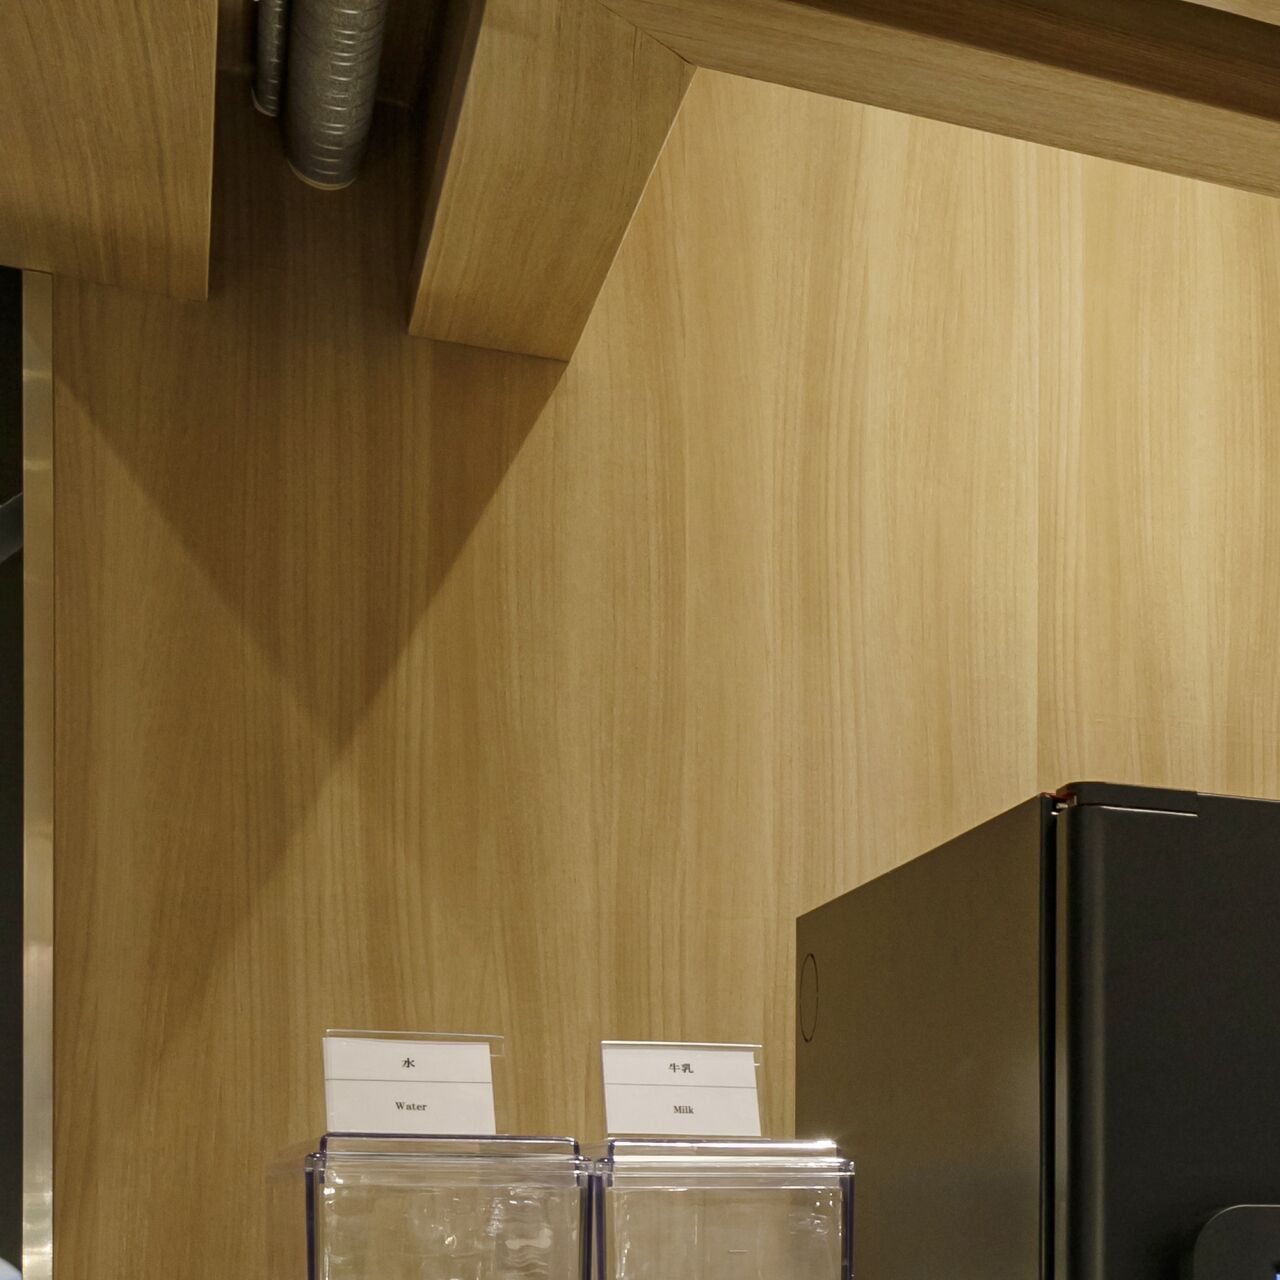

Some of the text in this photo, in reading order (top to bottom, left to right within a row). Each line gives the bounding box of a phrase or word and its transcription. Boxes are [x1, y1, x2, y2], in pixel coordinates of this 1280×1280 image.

[401, 1057, 415, 1069] 水
[669, 1062, 694, 1074] 牛乳
[395, 1101, 427, 1111] Water
[673, 1105, 694, 1114] Milk
